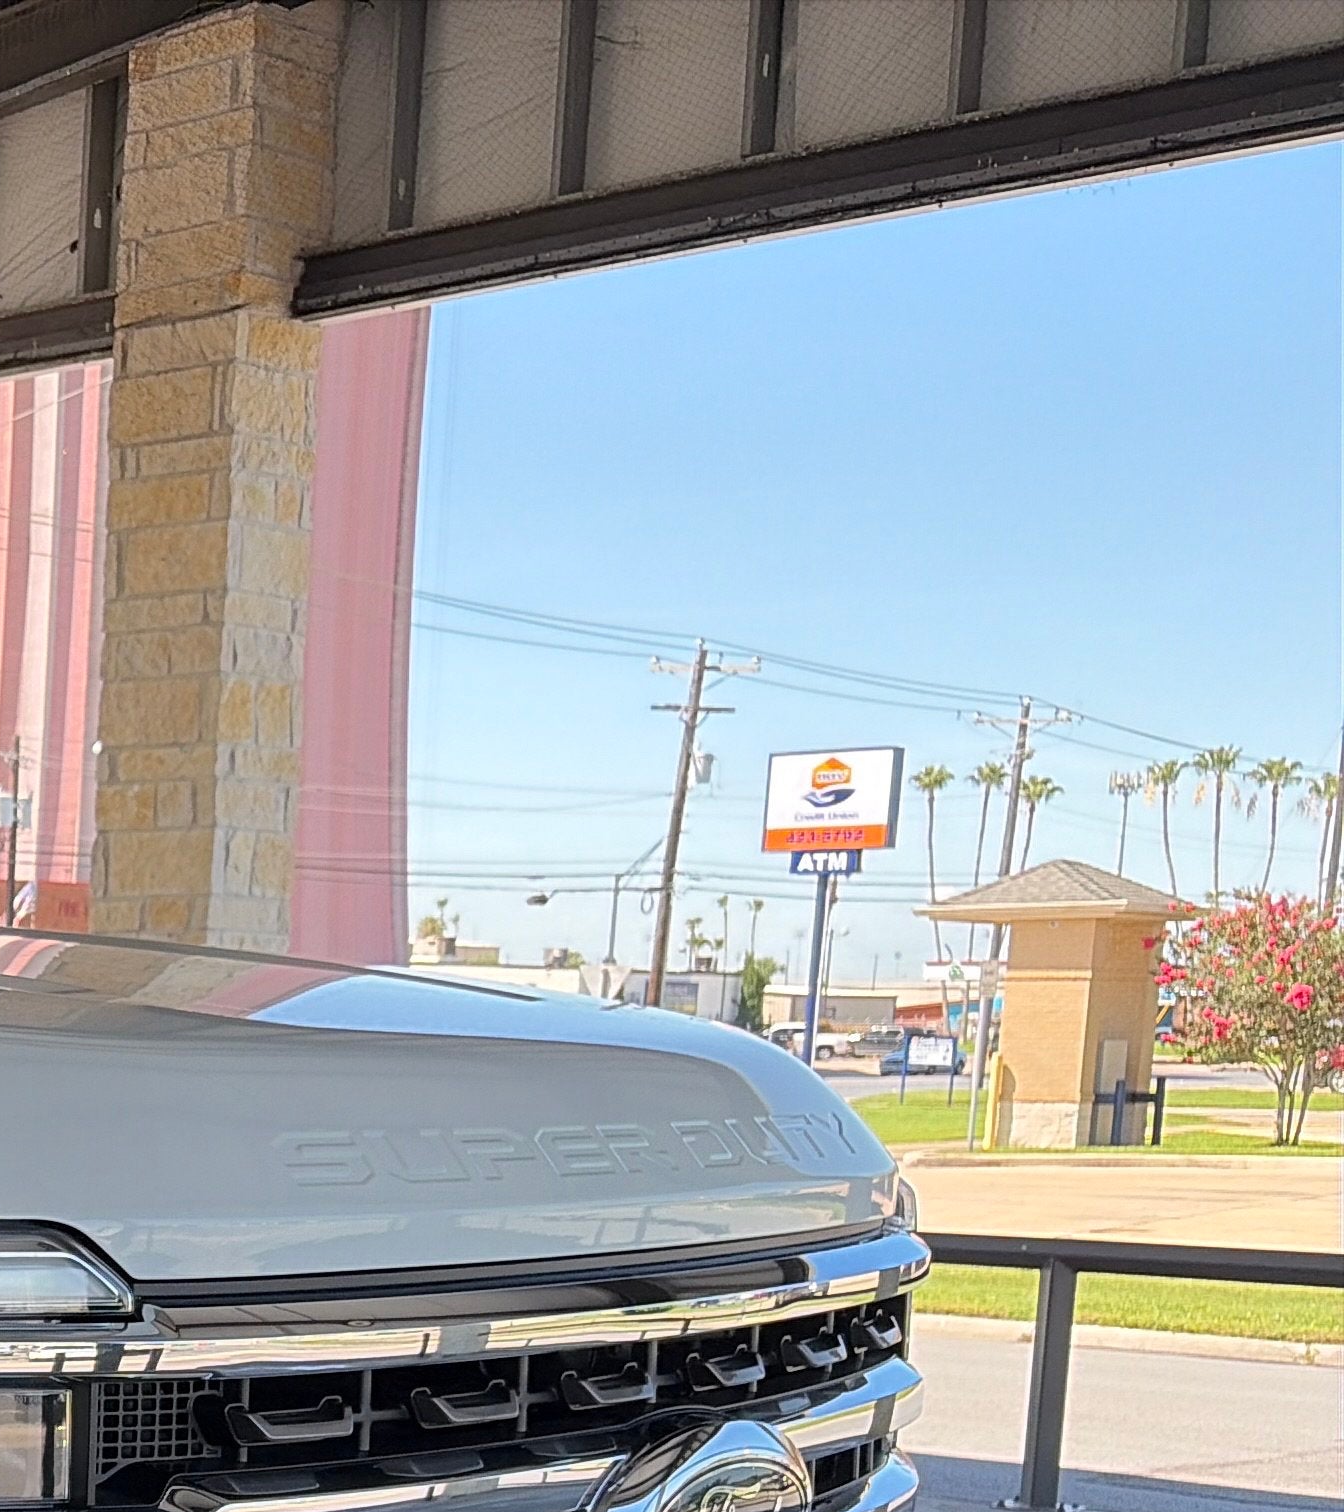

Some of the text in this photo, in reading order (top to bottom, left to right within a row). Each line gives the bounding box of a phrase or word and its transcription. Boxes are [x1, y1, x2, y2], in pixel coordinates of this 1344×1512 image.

[797, 851, 848, 872] ATM
[270, 1111, 857, 1187] SUPER DUTY
